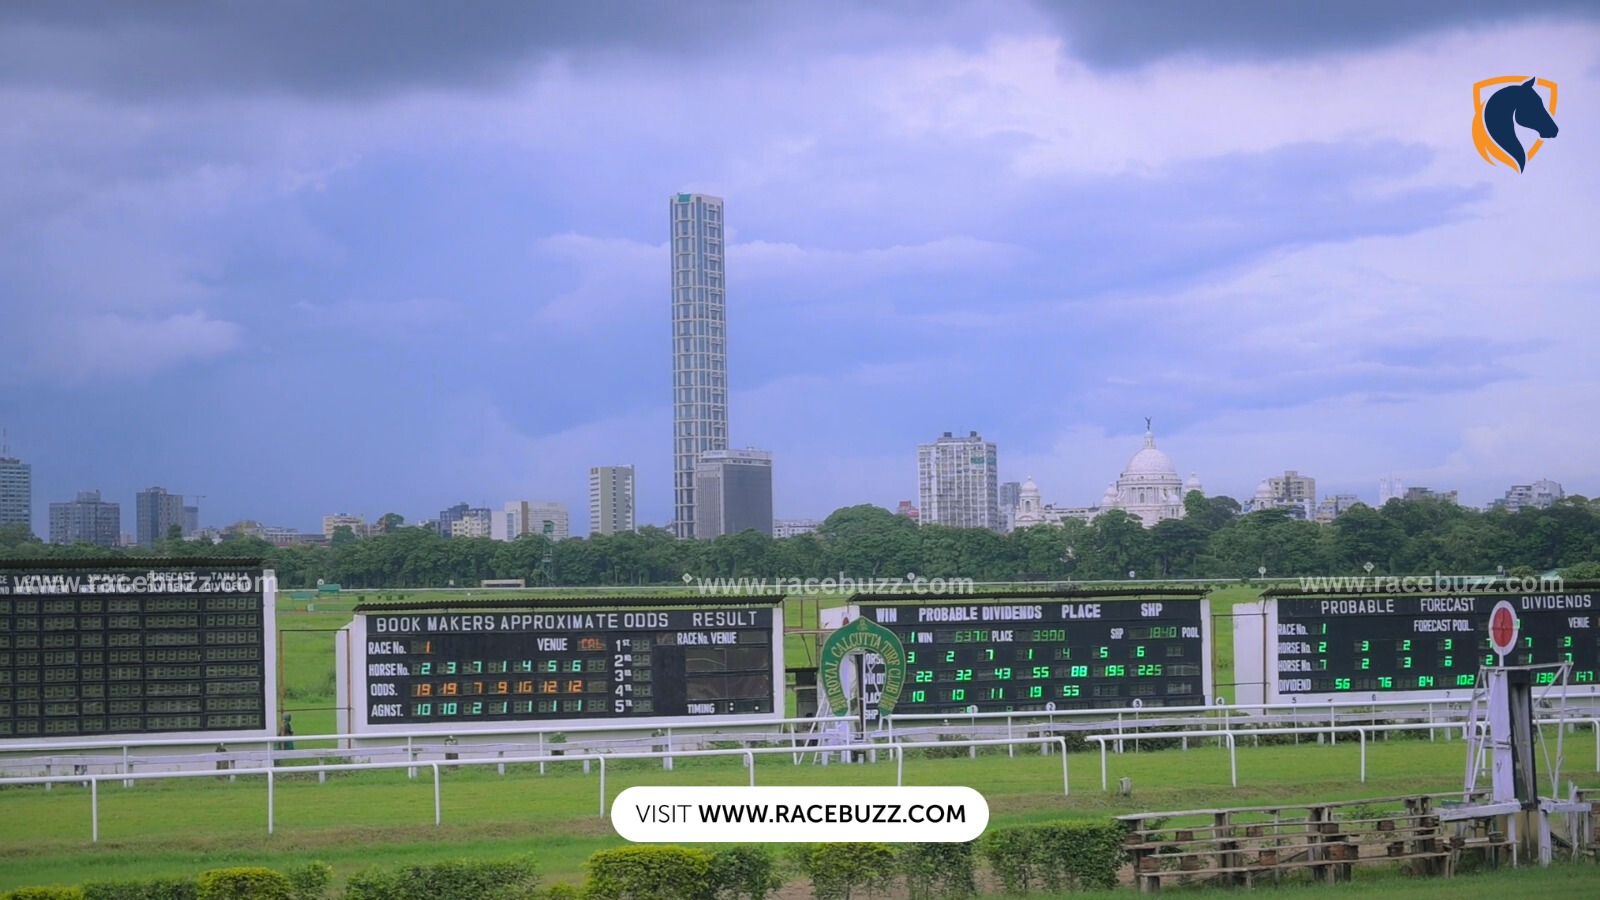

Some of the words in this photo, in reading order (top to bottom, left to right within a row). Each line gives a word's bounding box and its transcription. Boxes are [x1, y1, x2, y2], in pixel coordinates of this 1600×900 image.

[876, 608, 898, 623] WIN
[918, 606, 978, 622] PROBABLE
[982, 605, 1042, 620] DIVIDENDS
[1062, 604, 1101, 618] PLACE
[1140, 603, 1162, 617] SHP
[1321, 599, 1394, 614] PROBABLE
[1420, 598, 1475, 612] FORECAST
[1522, 595, 1592, 610] DIVIDENDS
[376, 617, 421, 632] BOOK
[427, 615, 495, 631] MAKERS
[500, 613, 618, 630] APPROXIMATE
[624, 612, 669, 628] ODDS
[692, 611, 758, 626] RESULT
[1322, 623, 1326, 634] 1
[1414, 619, 1451, 632] FORECAST
[1568, 617, 1590, 628] VENUE
[677, 633, 697, 644] RACE
[710, 632, 737, 644] VENUE
[918, 632, 933, 643] WIN
[992, 630, 1013, 642] PLACE
[1110, 628, 1124, 640] SHP
[1149, 627, 1177, 638] 1840
[1182, 626, 1200, 638] POOL
[368, 642, 392, 655] RACE
[393, 640, 407, 654] No.
[426, 641, 430, 653] 1
[537, 638, 568, 651] VENUE
[831, 632, 882, 658] CALCUTTA
[880, 640, 900, 666] TURF
[1319, 642, 1327, 653] 2
[1361, 641, 1369, 651] 3
[1403, 640, 1411, 650] 2
[1444, 639, 1452, 650] 3
[1525, 637, 1532, 647] 7
[1564, 636, 1571, 647] 3
[907, 652, 915, 663] 3
[946, 651, 955, 662] 2
[986, 649, 994, 661] 7
[1028, 648, 1033, 660] 1
[1062, 648, 1070, 659] 4
[1100, 647, 1108, 658] 5
[1137, 646, 1145, 657] 6
[1320, 659, 1327, 670] 7
[1362, 658, 1369, 669] 2
[1403, 657, 1411, 668] 3
[1486, 655, 1493, 665] 2
[1528, 653, 1532, 664] 1
[368, 662, 397, 676] HORSE
[397, 662, 410, 676] No.
[421, 662, 431, 675] 2
[446, 662, 456, 674] 3
[473, 661, 482, 674] 7
[502, 661, 506, 672] 1
[522, 660, 532, 672] 4
[548, 660, 557, 672] 5
[572, 660, 582, 671] 6
[916, 671, 933, 682] 22
[955, 669, 972, 681] 32
[994, 668, 1011, 680] 43
[1032, 667, 1050, 678] 55
[1071, 666, 1088, 677] 88
[1105, 665, 1125, 676] 195
[1138, 664, 1162, 676] 225
[824, 660, 841, 696] ROYAL
[886, 668, 901, 694] CLUB
[1279, 678, 1312, 691] DIVIDEND
[1335, 678, 1350, 689] 56
[1377, 677, 1392, 688] 76
[1418, 676, 1433, 687] 84
[1456, 675, 1475, 686] 102
[1536, 672, 1555, 684] 138
[370, 683, 398, 696] ODDS.
[417, 683, 431, 696] 19
[443, 683, 457, 695] 19
[473, 682, 482, 694] 7
[498, 682, 507, 694] 9
[544, 681, 557, 693] 12
[569, 680, 582, 692] 12
[912, 690, 925, 702] 10
[991, 688, 1003, 699] 11
[1030, 686, 1042, 697] 19
[1063, 685, 1080, 696] 55
[371, 704, 403, 717] AGNST.
[417, 703, 431, 715] 10
[443, 703, 457, 715] 10
[473, 702, 482, 714] 2
[503, 702, 507, 713] 1
[528, 700, 532, 712] 1
[553, 700, 557, 712] 1
[578, 700, 582, 711] 1
[687, 703, 715, 714] TIMING
